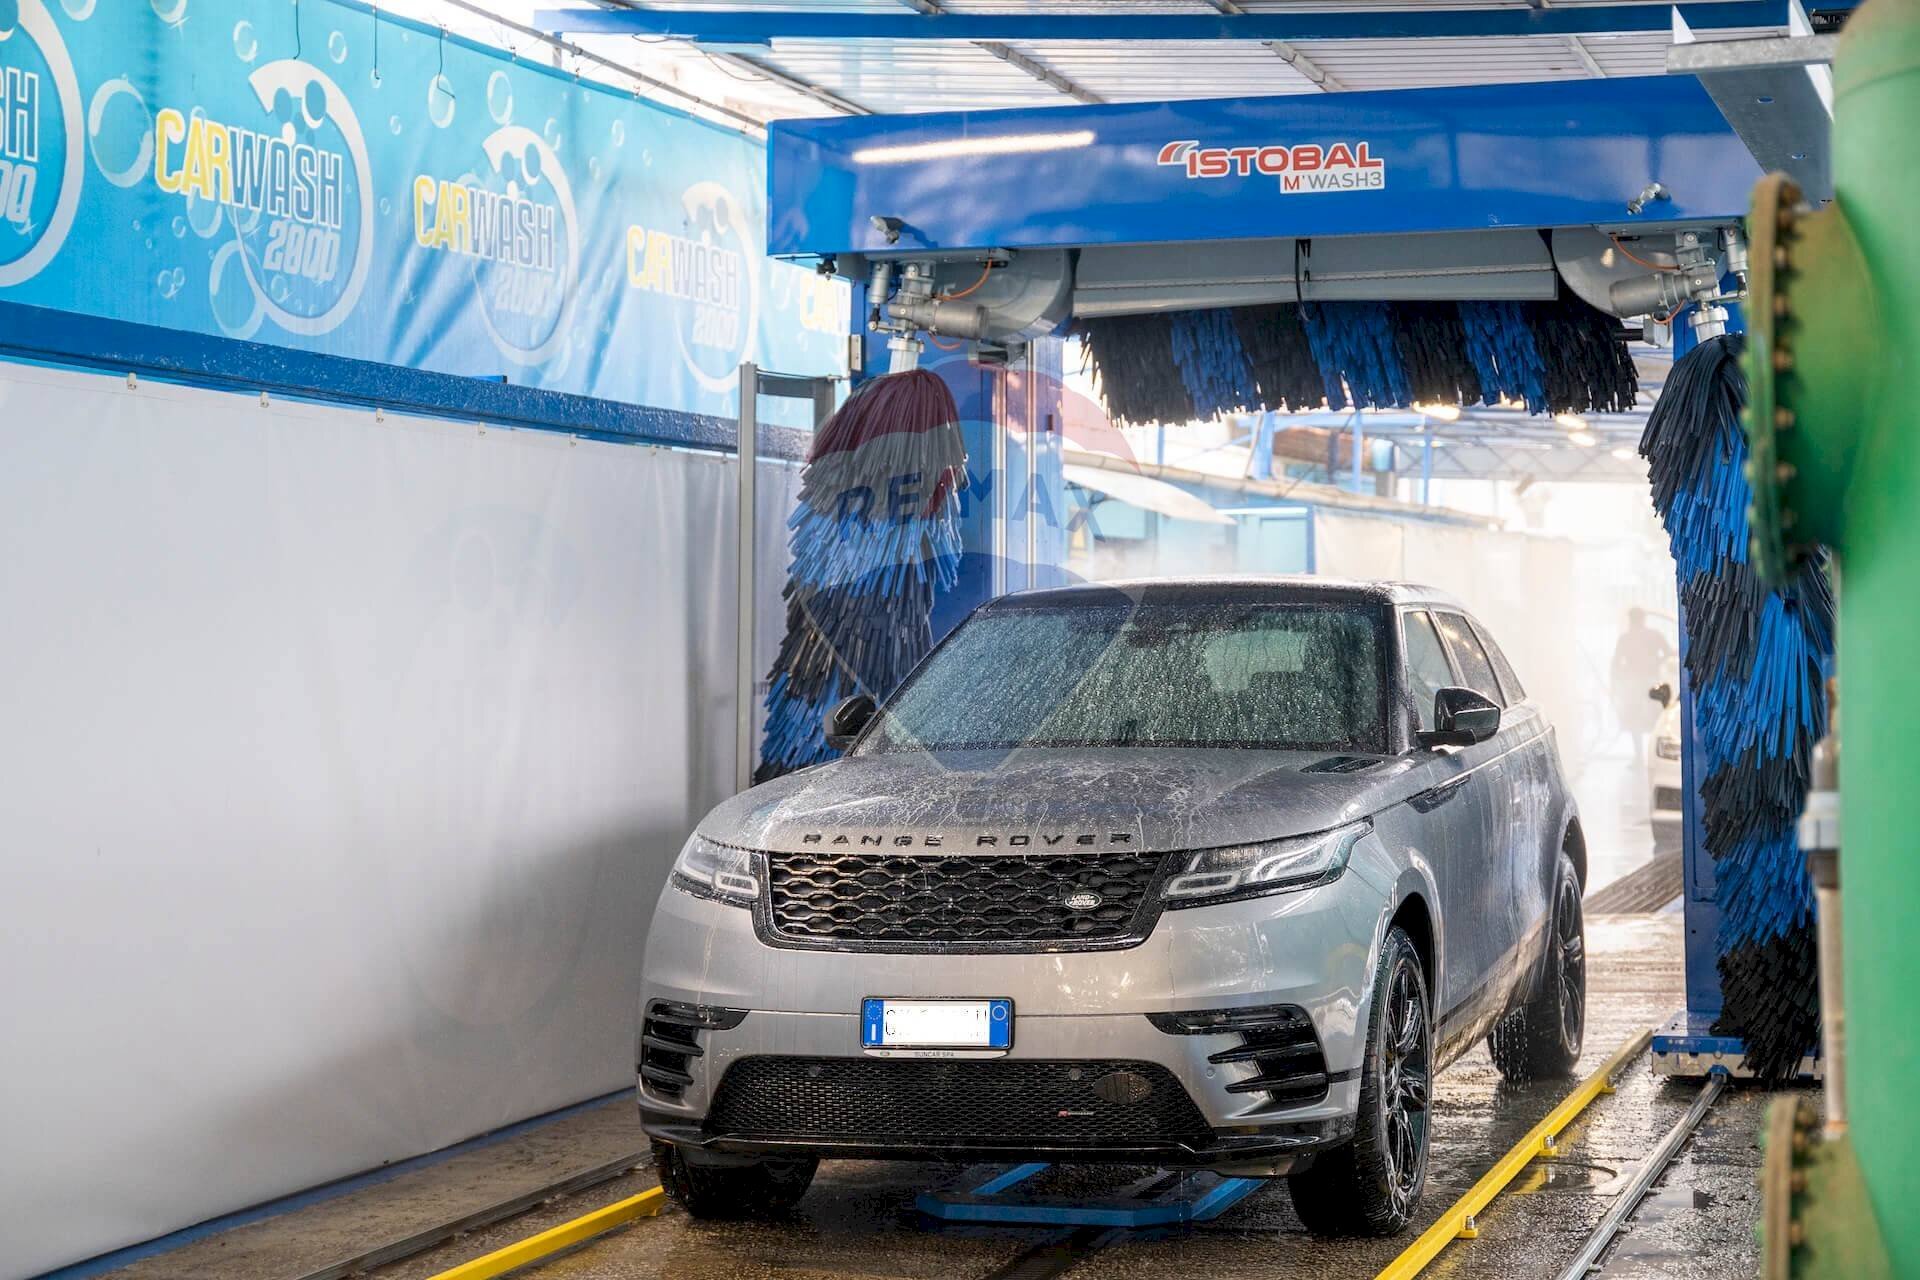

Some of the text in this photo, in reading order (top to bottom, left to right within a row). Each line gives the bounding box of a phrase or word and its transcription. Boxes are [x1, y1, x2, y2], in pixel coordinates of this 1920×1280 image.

[1187, 142, 1384, 177] ISTOBAL
[1283, 170, 1383, 191] M'WASH3
[263, 219, 340, 281] 2000
[802, 833, 1131, 847] RANGE ROVER
